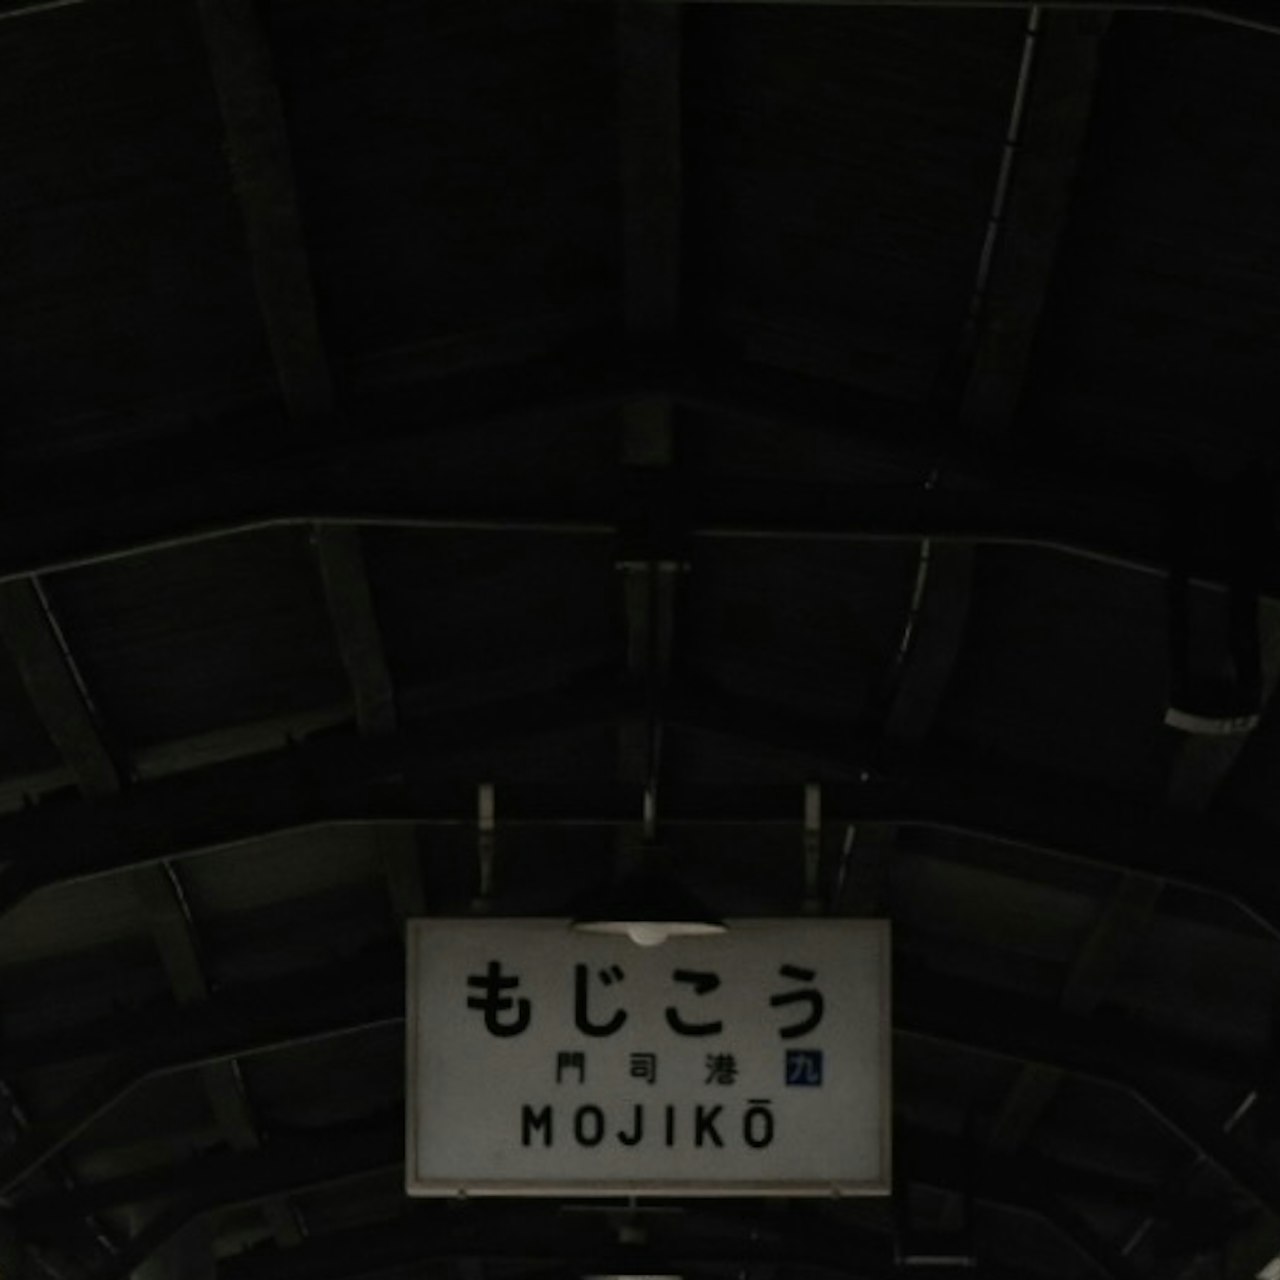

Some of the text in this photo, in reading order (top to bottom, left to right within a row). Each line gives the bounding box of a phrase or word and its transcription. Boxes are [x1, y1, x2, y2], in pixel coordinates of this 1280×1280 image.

[466, 959, 826, 1040] もじこう
[556, 1051, 820, 1086] 門司港 九
[521, 1098, 775, 1149] MOJIKŌ
